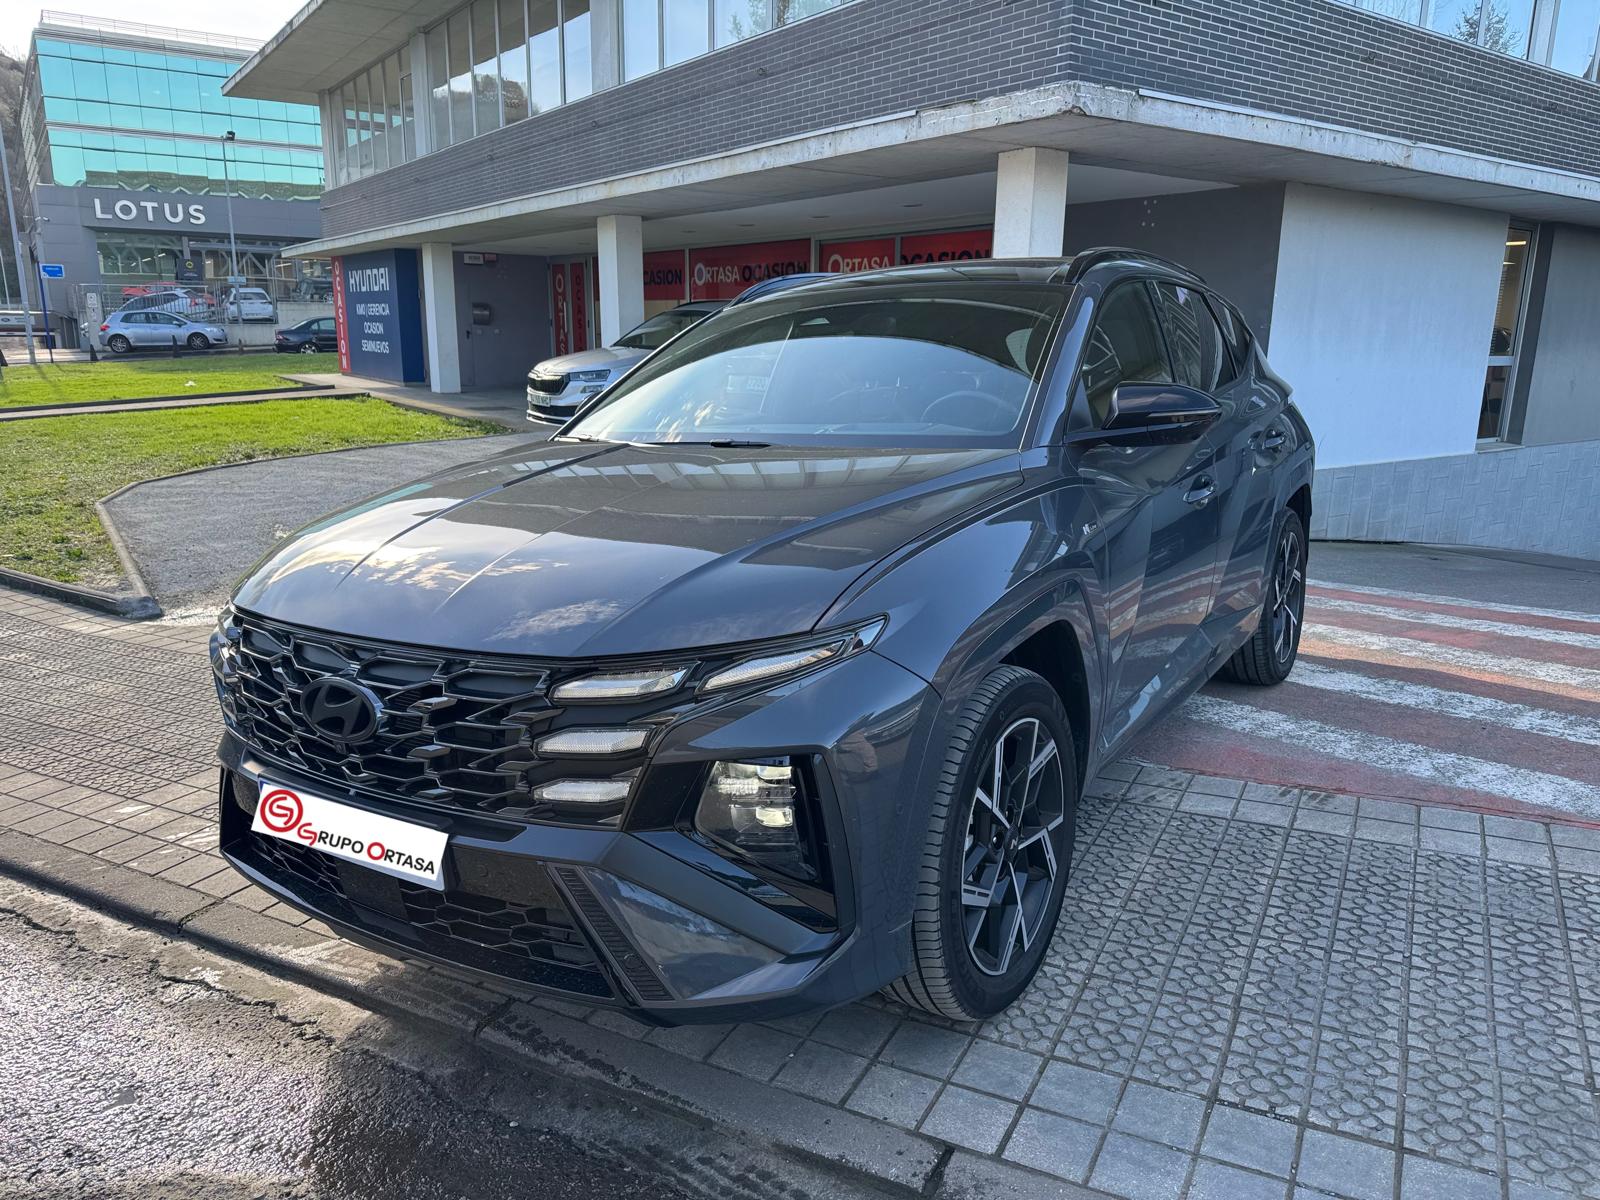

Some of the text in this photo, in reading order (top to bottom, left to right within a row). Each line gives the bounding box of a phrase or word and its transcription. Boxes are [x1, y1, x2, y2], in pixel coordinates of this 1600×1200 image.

[94, 197, 206, 225] LOTUS
[348, 267, 390, 292] HYUNDAI
[643, 269, 682, 286] CASION
[694, 262, 740, 286] ORTASA
[334, 261, 347, 369] OCASION
[367, 303, 390, 316] GERENCIA
[555, 273, 566, 356] ORTAS
[363, 321, 384, 335] OCASION
[361, 339, 390, 354] SEMINUEVOS
